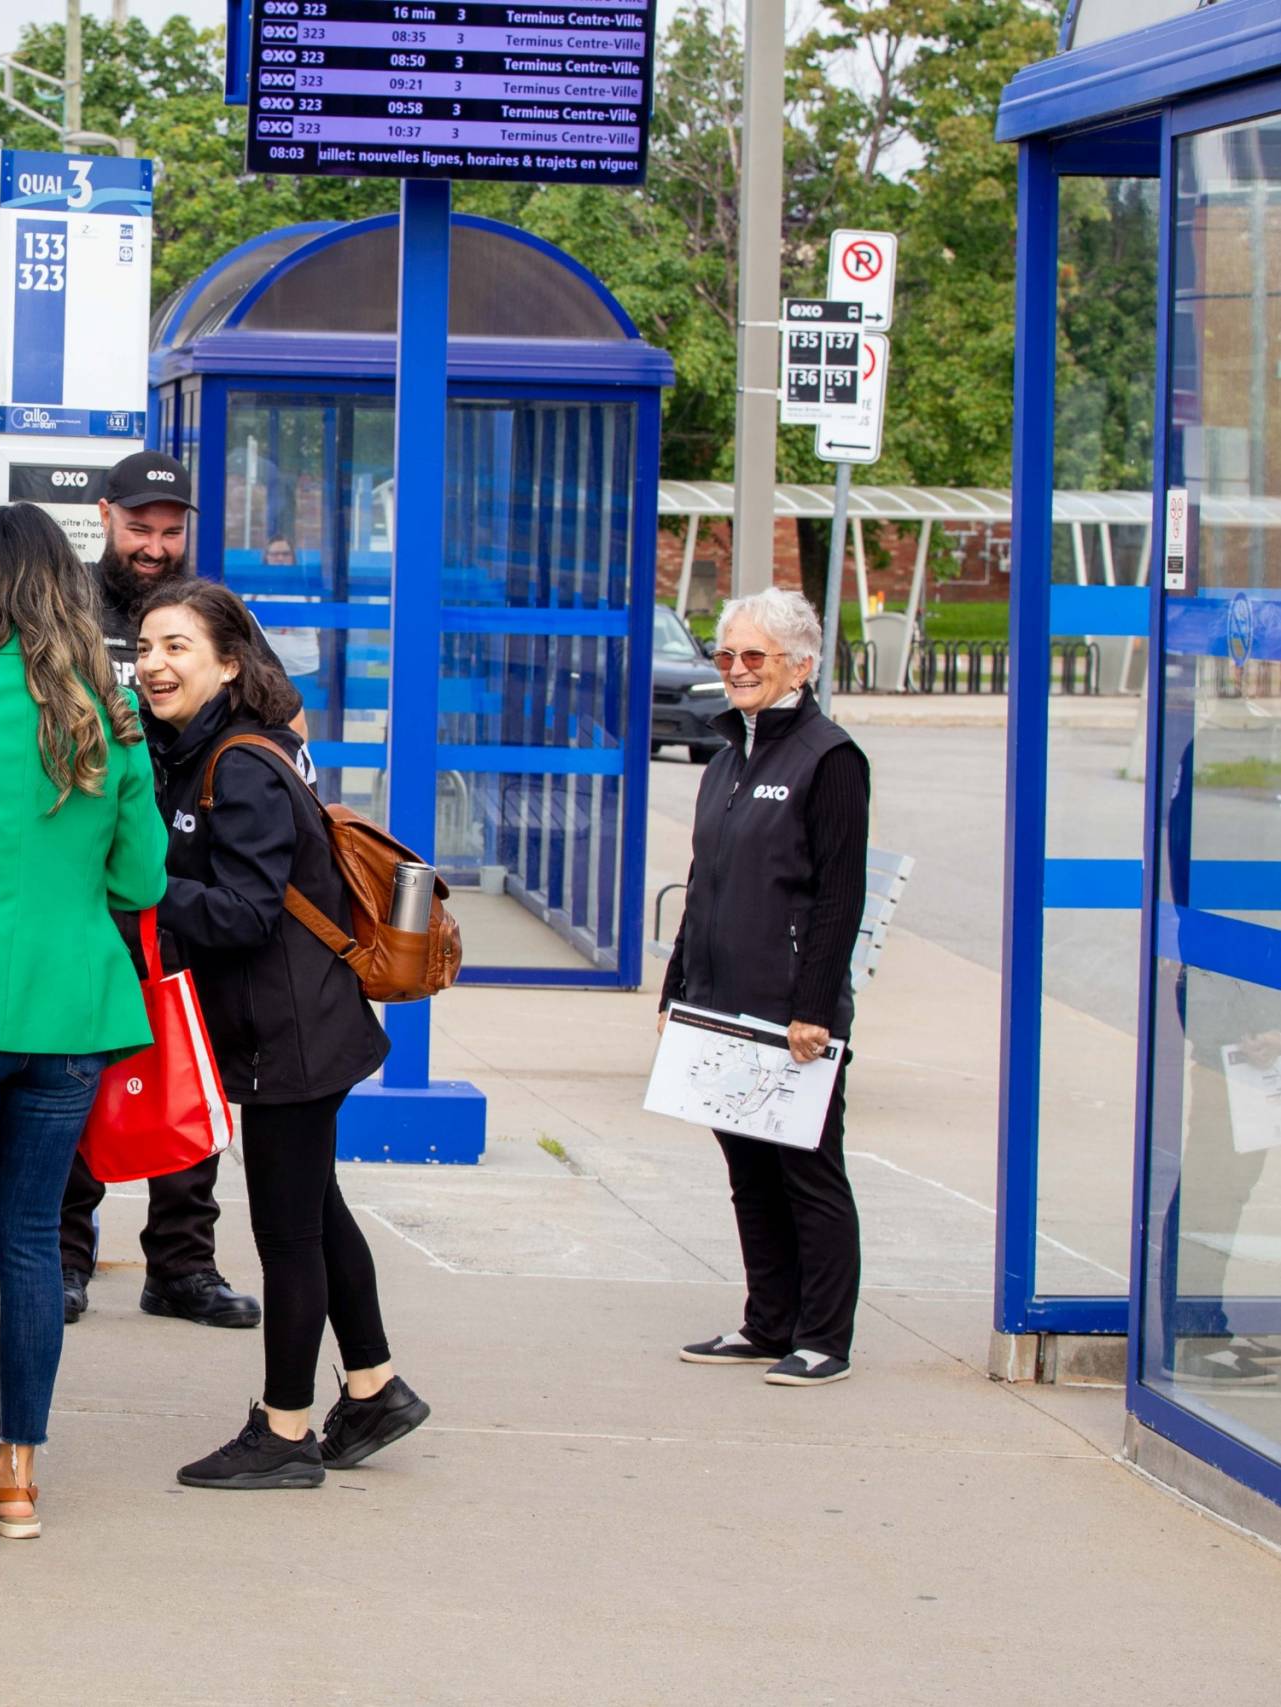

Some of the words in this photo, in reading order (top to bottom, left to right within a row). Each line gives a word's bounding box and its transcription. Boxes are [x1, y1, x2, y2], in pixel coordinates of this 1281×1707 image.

[264, 2, 298, 14] exo
[304, 4, 326, 16] 323
[394, 6, 408, 18] 16
[412, 8, 436, 20] min
[458, 8, 466, 21] 3
[506, 10, 564, 24] Terminus
[568, 12, 643, 27] Centre-Ville
[263, 25, 297, 39] exo
[303, 28, 325, 39] 323
[392, 31, 426, 42] 08:35
[457, 33, 464, 44] 3
[506, 35, 562, 48] Terminus
[567, 37, 640, 50] Centre-Ville
[262, 50, 296, 62] exo
[301, 51, 324, 63] 323
[390, 54, 426, 67] 08:50
[455, 56, 464, 68] 3
[504, 58, 562, 72] Terminus
[566, 60, 640, 75] Centre-Ville
[260, 73, 295, 86] exo
[300, 76, 323, 87] 323
[390, 78, 422, 90] 09:21
[454, 81, 462, 91] 3
[504, 82, 560, 95] Terminus
[564, 84, 638, 98] Centre-Ville
[259, 97, 294, 110] exo
[298, 99, 322, 111] 323
[388, 102, 423, 114] 09:58
[452, 104, 461, 116] 3
[501, 105, 559, 119] Terminus
[562, 108, 637, 122] Centre-Ville
[258, 121, 293, 134] exo
[298, 123, 320, 134] 323
[388, 126, 421, 138] 10:37
[452, 128, 459, 139] 3
[500, 129, 557, 143] Terminus
[562, 132, 635, 145] Centre-Ville
[270, 146, 304, 159] 08:03
[359, 150, 420, 164] nouvelles
[422, 151, 463, 168] lignes,
[467, 152, 519, 166] horaires
[522, 156, 532, 167] &
[536, 156, 577, 171] trajets
[581, 159, 596, 168] en
[18, 173, 62, 195] QUAI
[67, 160, 93, 208] 3
[24, 232, 65, 260] 133
[18, 264, 64, 292] 323
[790, 304, 822, 317] exo
[790, 332, 819, 347] T35
[826, 333, 854, 349] T37
[789, 370, 818, 385] T36
[826, 370, 851, 387] T51
[23, 408, 49, 422] allo
[51, 471, 88, 487] exo
[147, 470, 176, 482] exo
[753, 784, 789, 801] exo
